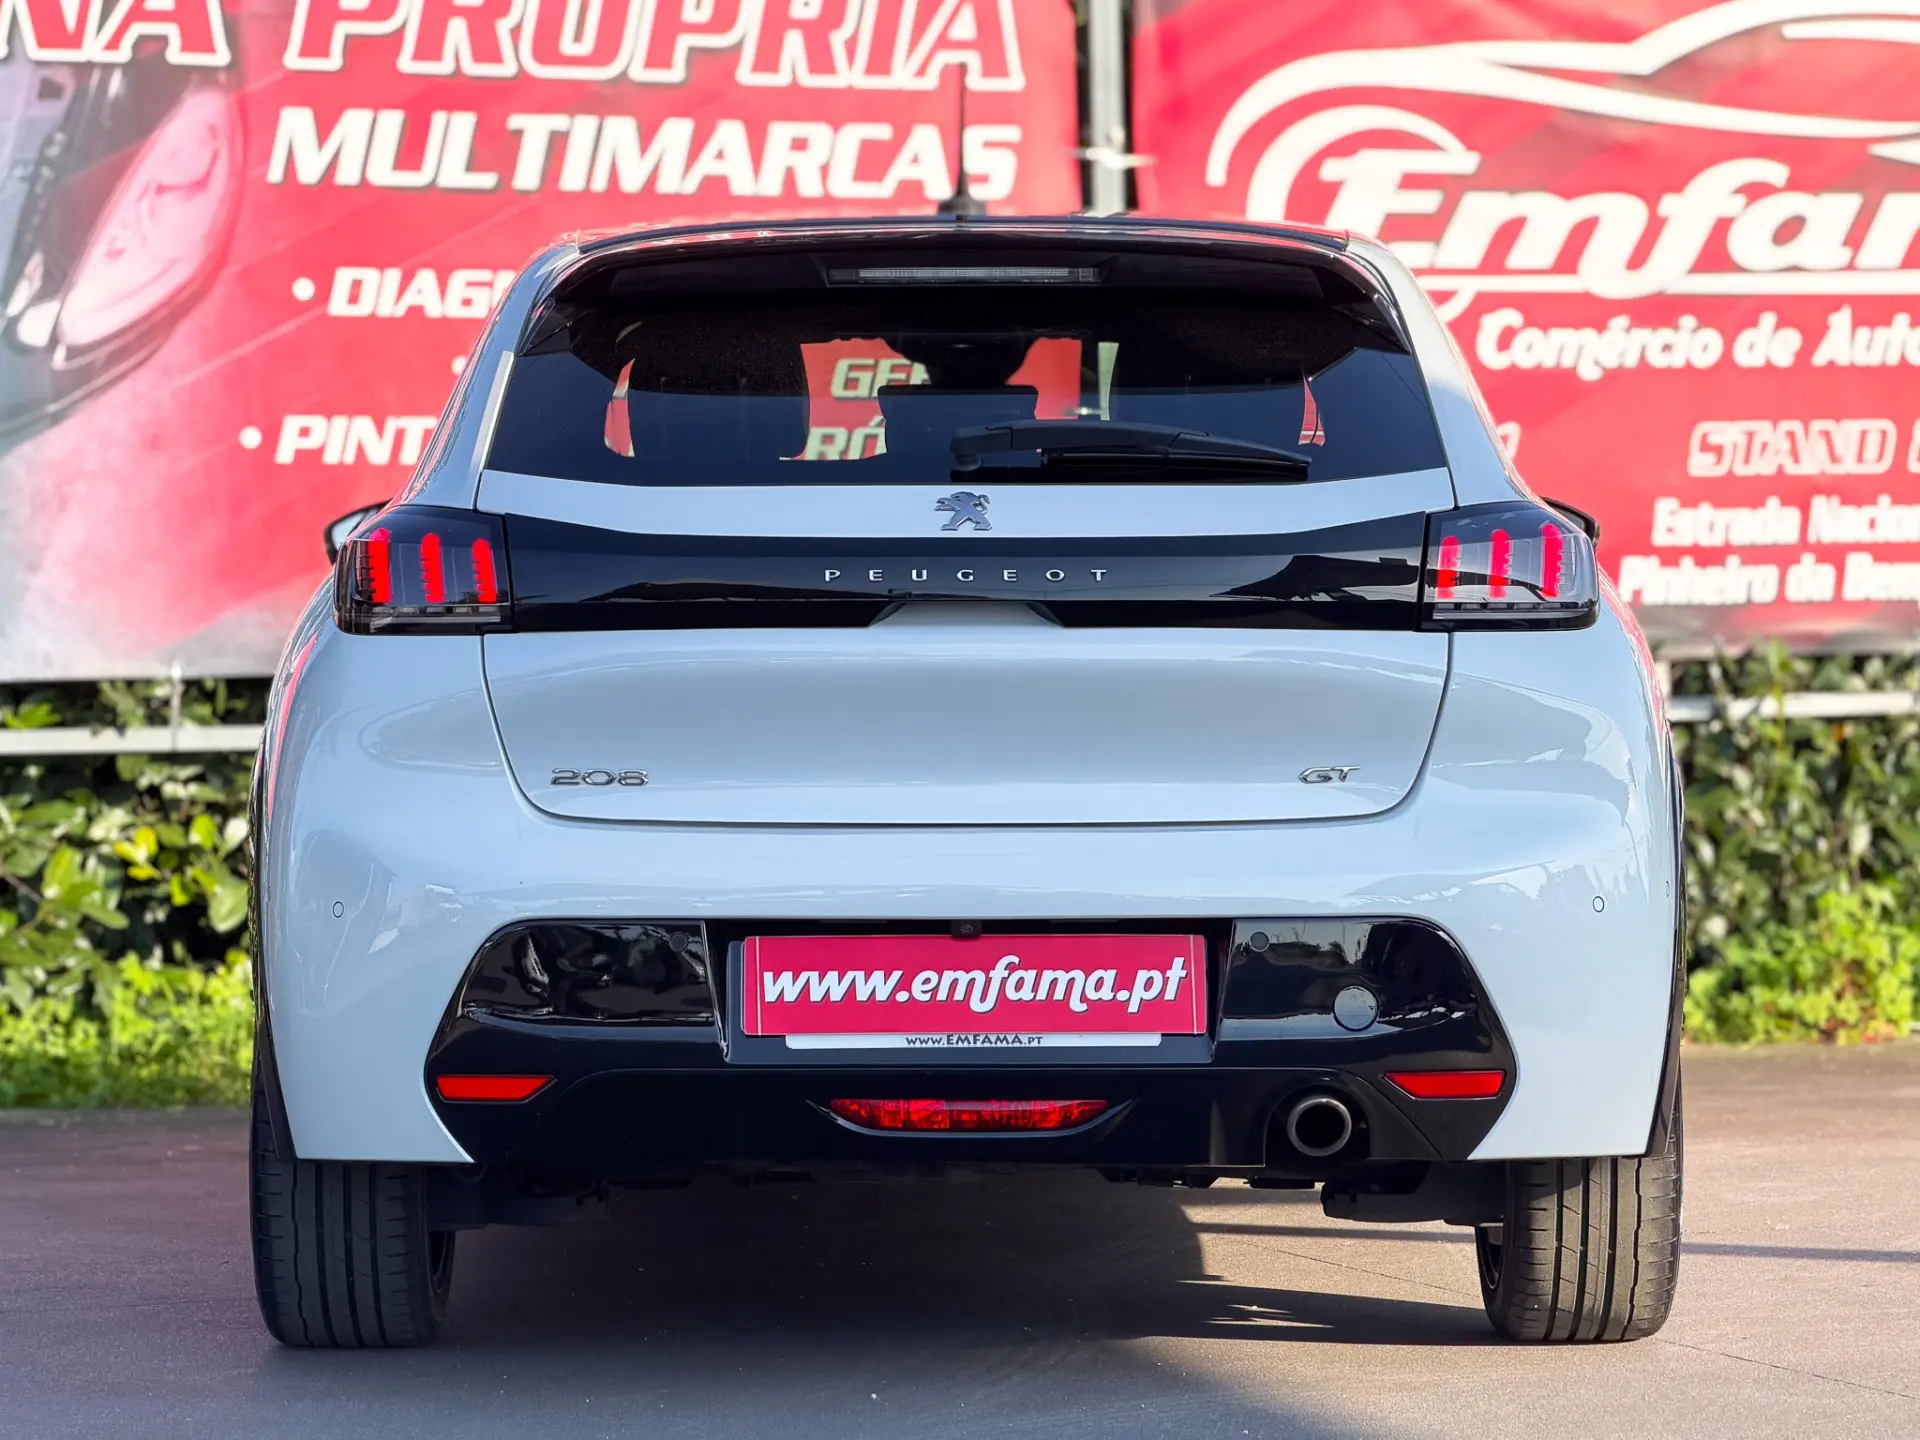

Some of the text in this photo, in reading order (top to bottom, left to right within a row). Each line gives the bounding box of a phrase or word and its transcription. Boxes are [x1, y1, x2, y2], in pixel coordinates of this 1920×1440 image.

[0, 0, 231, 67] NA
[267, 106, 1022, 201] MULTIMARCAS
[1476, 308, 1723, 381] Comércio
[1733, 311, 1802, 368] de
[1687, 418, 1897, 477] STAND
[1651, 496, 1801, 546] Estrada
[824, 569, 1107, 582] PEUGEOT
[1618, 551, 1920, 605] Pinheiro da Bem
[551, 768, 648, 786] 208
[1298, 765, 1361, 784] GT
[763, 954, 1187, 1014] www.emfama.pt
